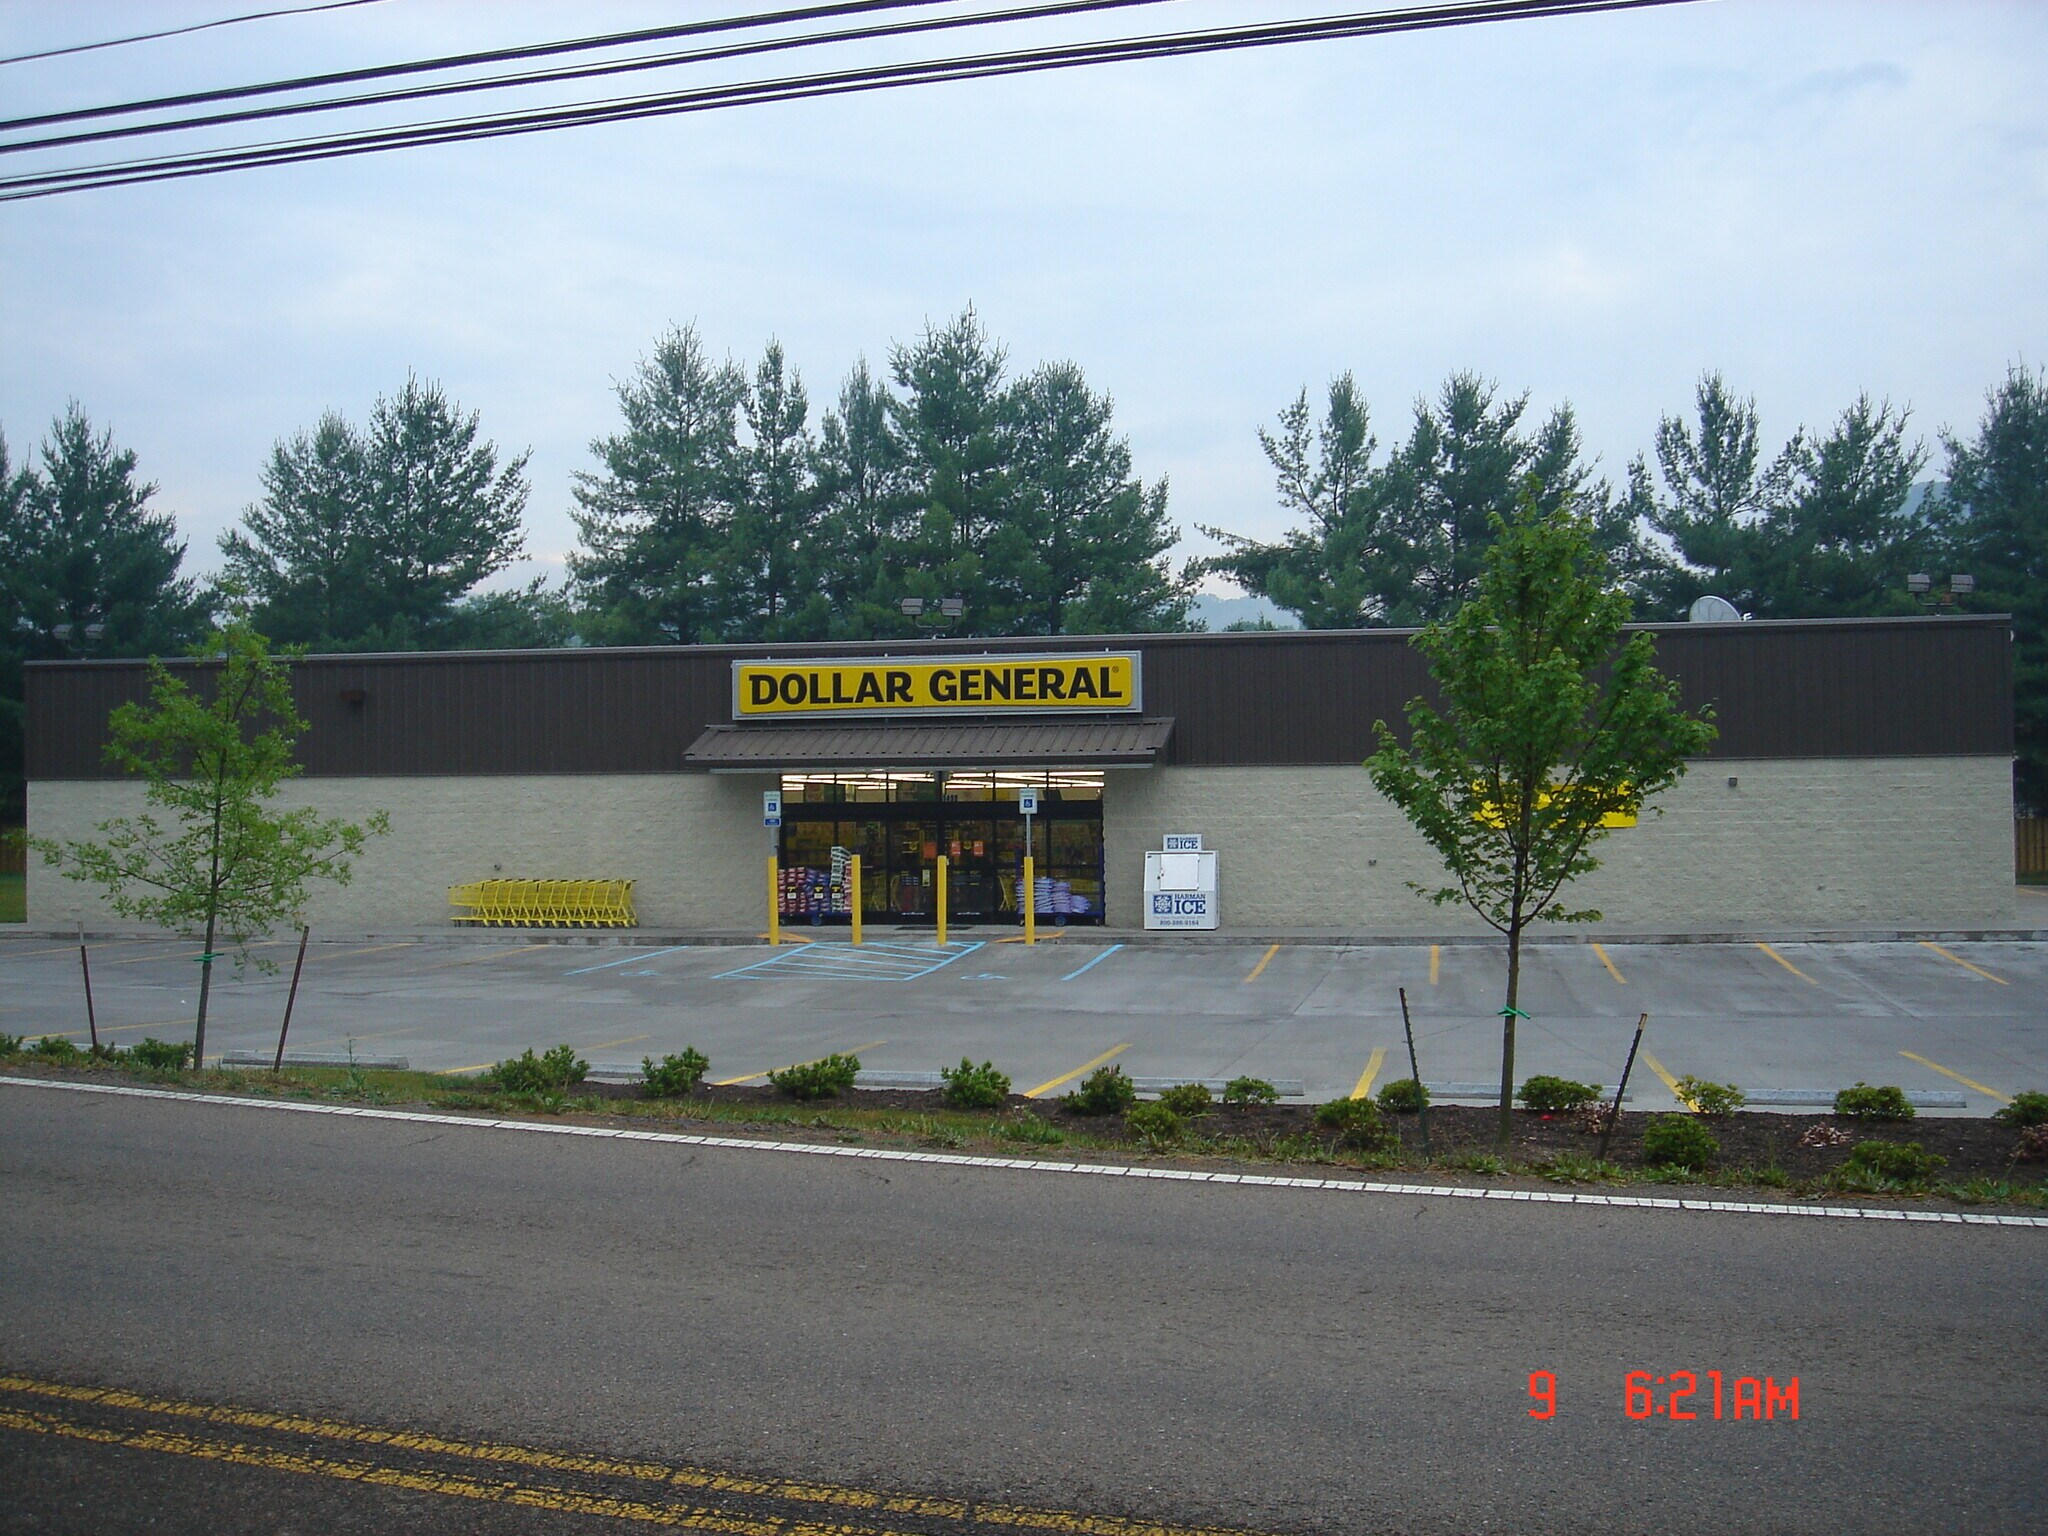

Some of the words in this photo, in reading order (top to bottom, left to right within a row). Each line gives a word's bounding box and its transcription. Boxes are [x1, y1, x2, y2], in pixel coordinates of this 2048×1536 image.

[749, 671, 913, 705] DOLLAR
[1179, 841, 1198, 849] ICE
[1174, 900, 1206, 914] ICE
